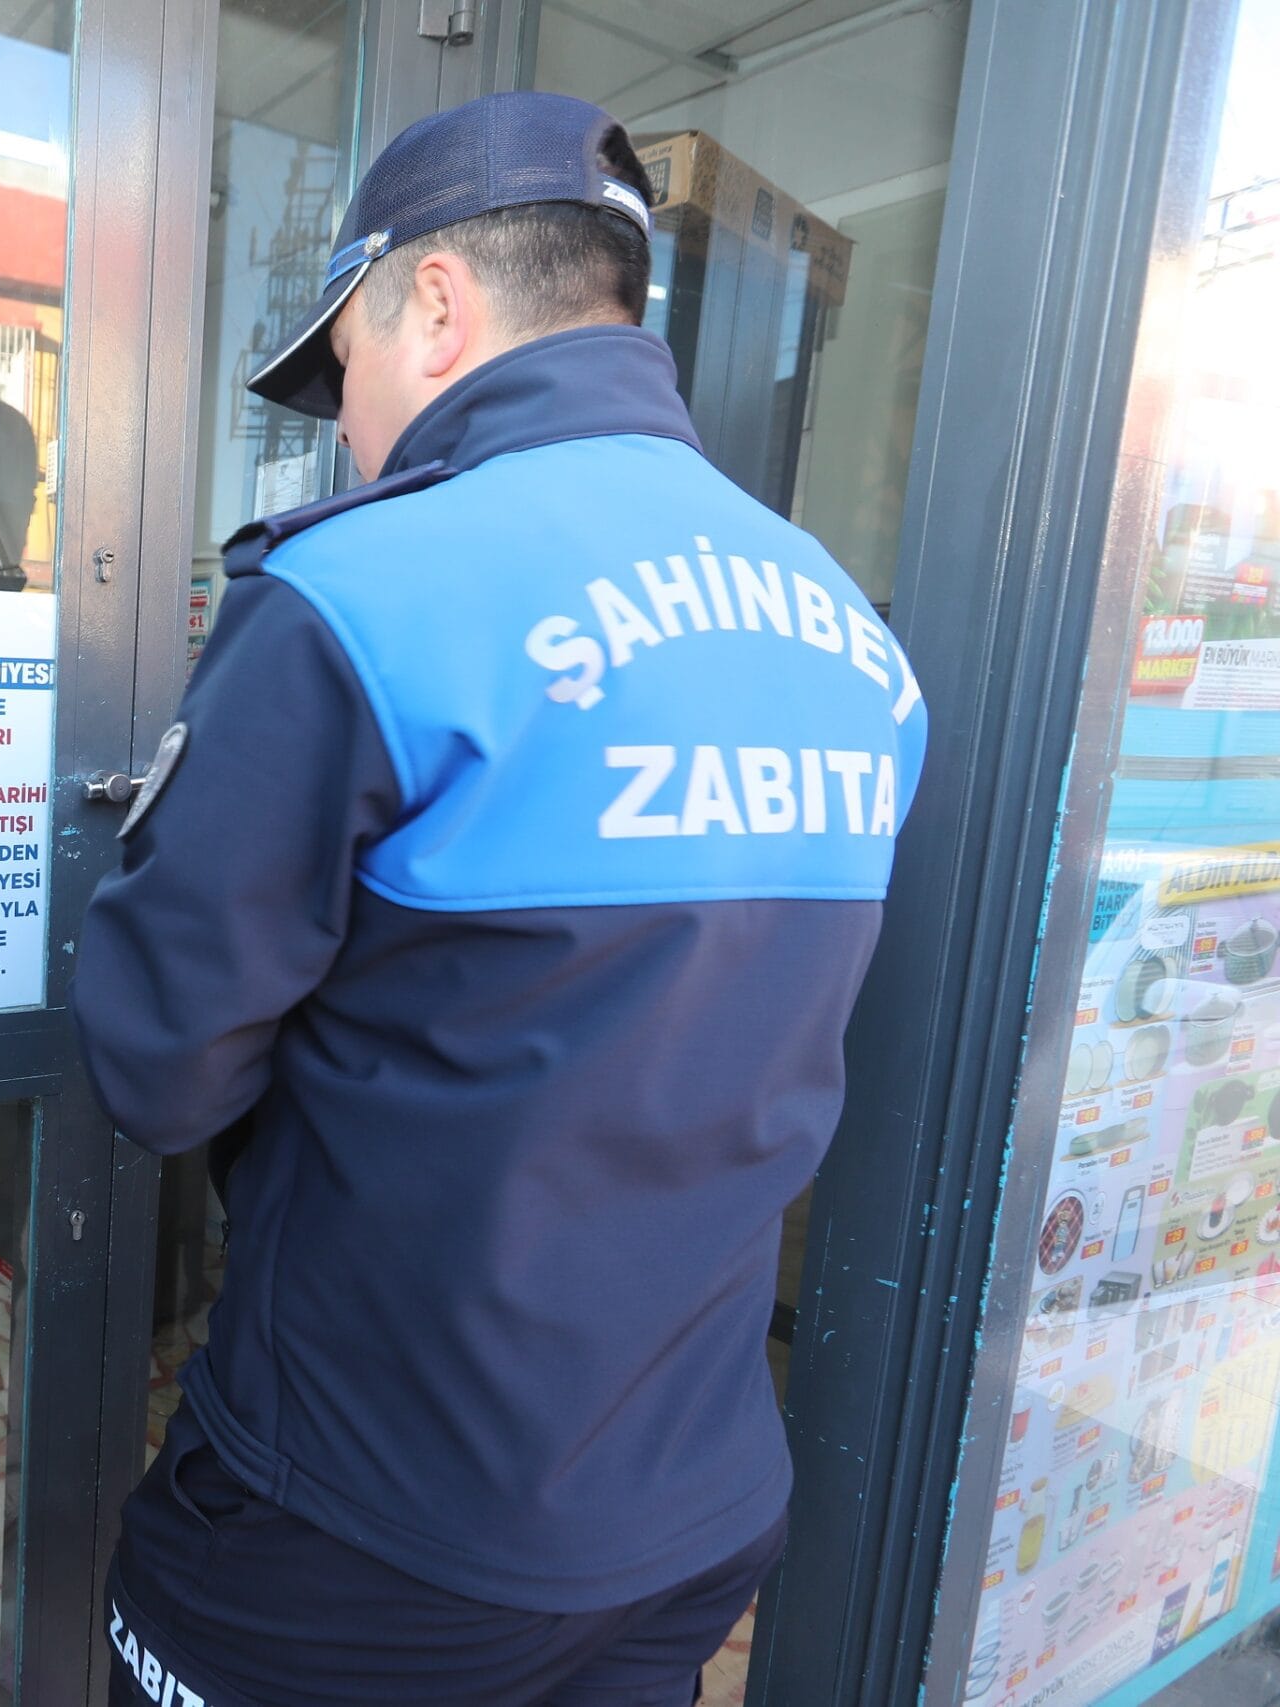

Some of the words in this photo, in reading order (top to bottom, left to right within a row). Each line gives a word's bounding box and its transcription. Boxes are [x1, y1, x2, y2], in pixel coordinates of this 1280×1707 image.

[525, 536, 921, 726] ŞAHİNBEY
[598, 745, 895, 839] ZABITA
[110, 1598, 214, 1707] ZABIT
